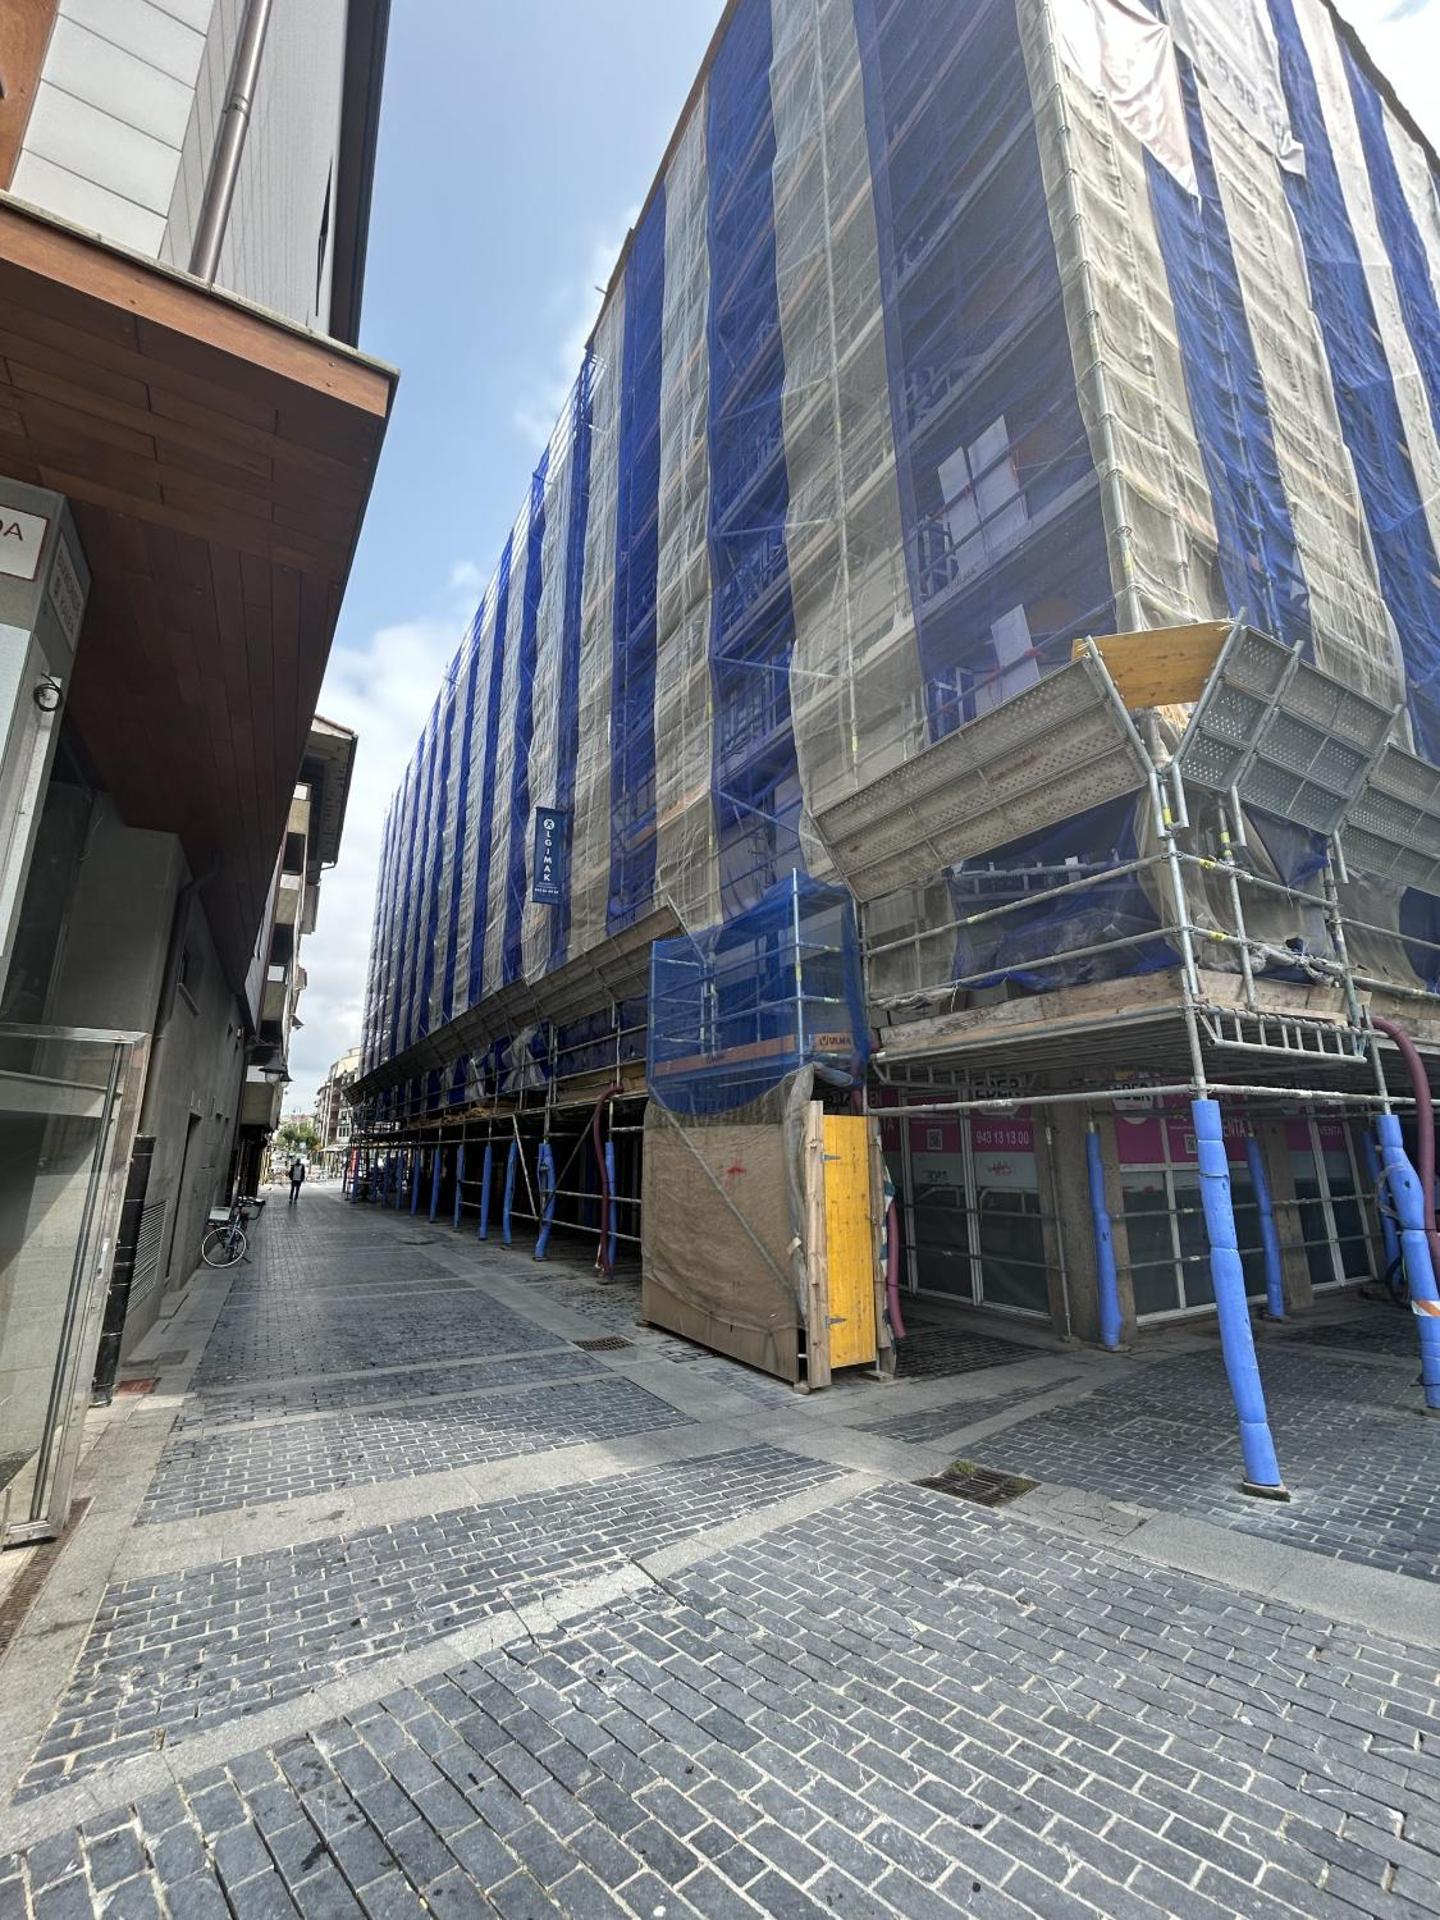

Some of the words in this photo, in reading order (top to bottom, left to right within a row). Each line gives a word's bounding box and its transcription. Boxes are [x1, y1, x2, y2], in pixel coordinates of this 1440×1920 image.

[0, 519, 24, 542] A
[1223, 1118, 1247, 1137] ENTA
[976, 1131, 992, 1144] 943
[994, 1131, 1004, 1144] 13
[1006, 1131, 1016, 1144] 13
[1018, 1131, 1030, 1145] 00
